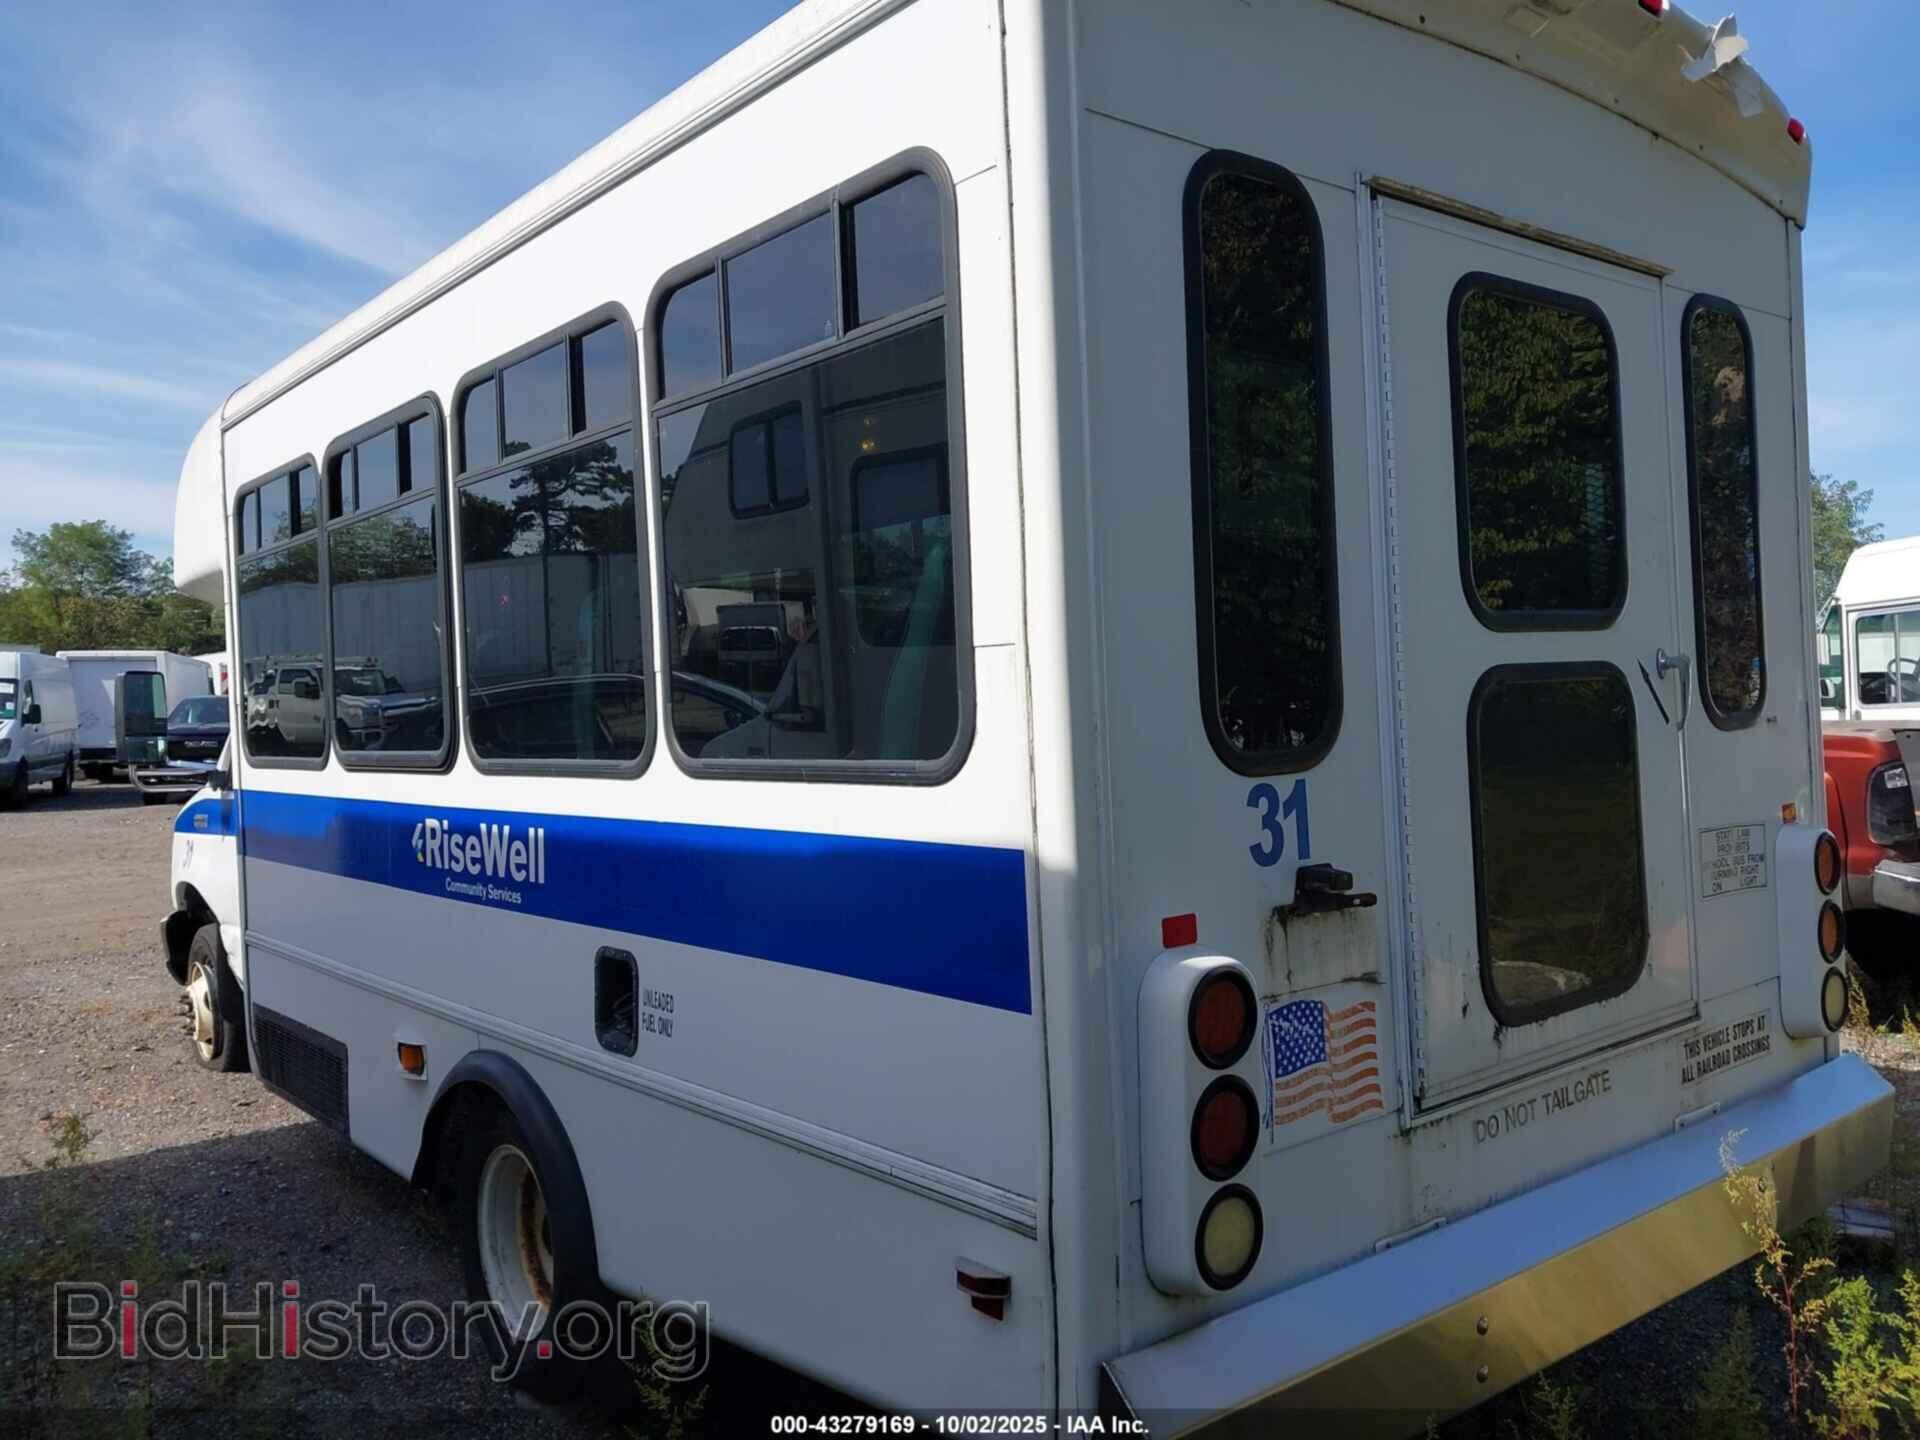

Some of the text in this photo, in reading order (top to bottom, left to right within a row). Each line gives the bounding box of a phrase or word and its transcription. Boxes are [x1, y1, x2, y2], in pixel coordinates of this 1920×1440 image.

[1246, 778, 1310, 867] 31
[425, 818, 545, 884] RiseWell
[445, 877, 522, 904] Community Services
[642, 988, 674, 1013] UNLEADED
[642, 1011, 673, 1038] FUEL ONLY
[1681, 1034, 1771, 1085] ALL RAILROAD CROSSINGS
[1684, 1015, 1766, 1061] THIS VEHICLE STOPS AT
[1473, 1070, 1612, 1144] DO NOT TAILGATE
